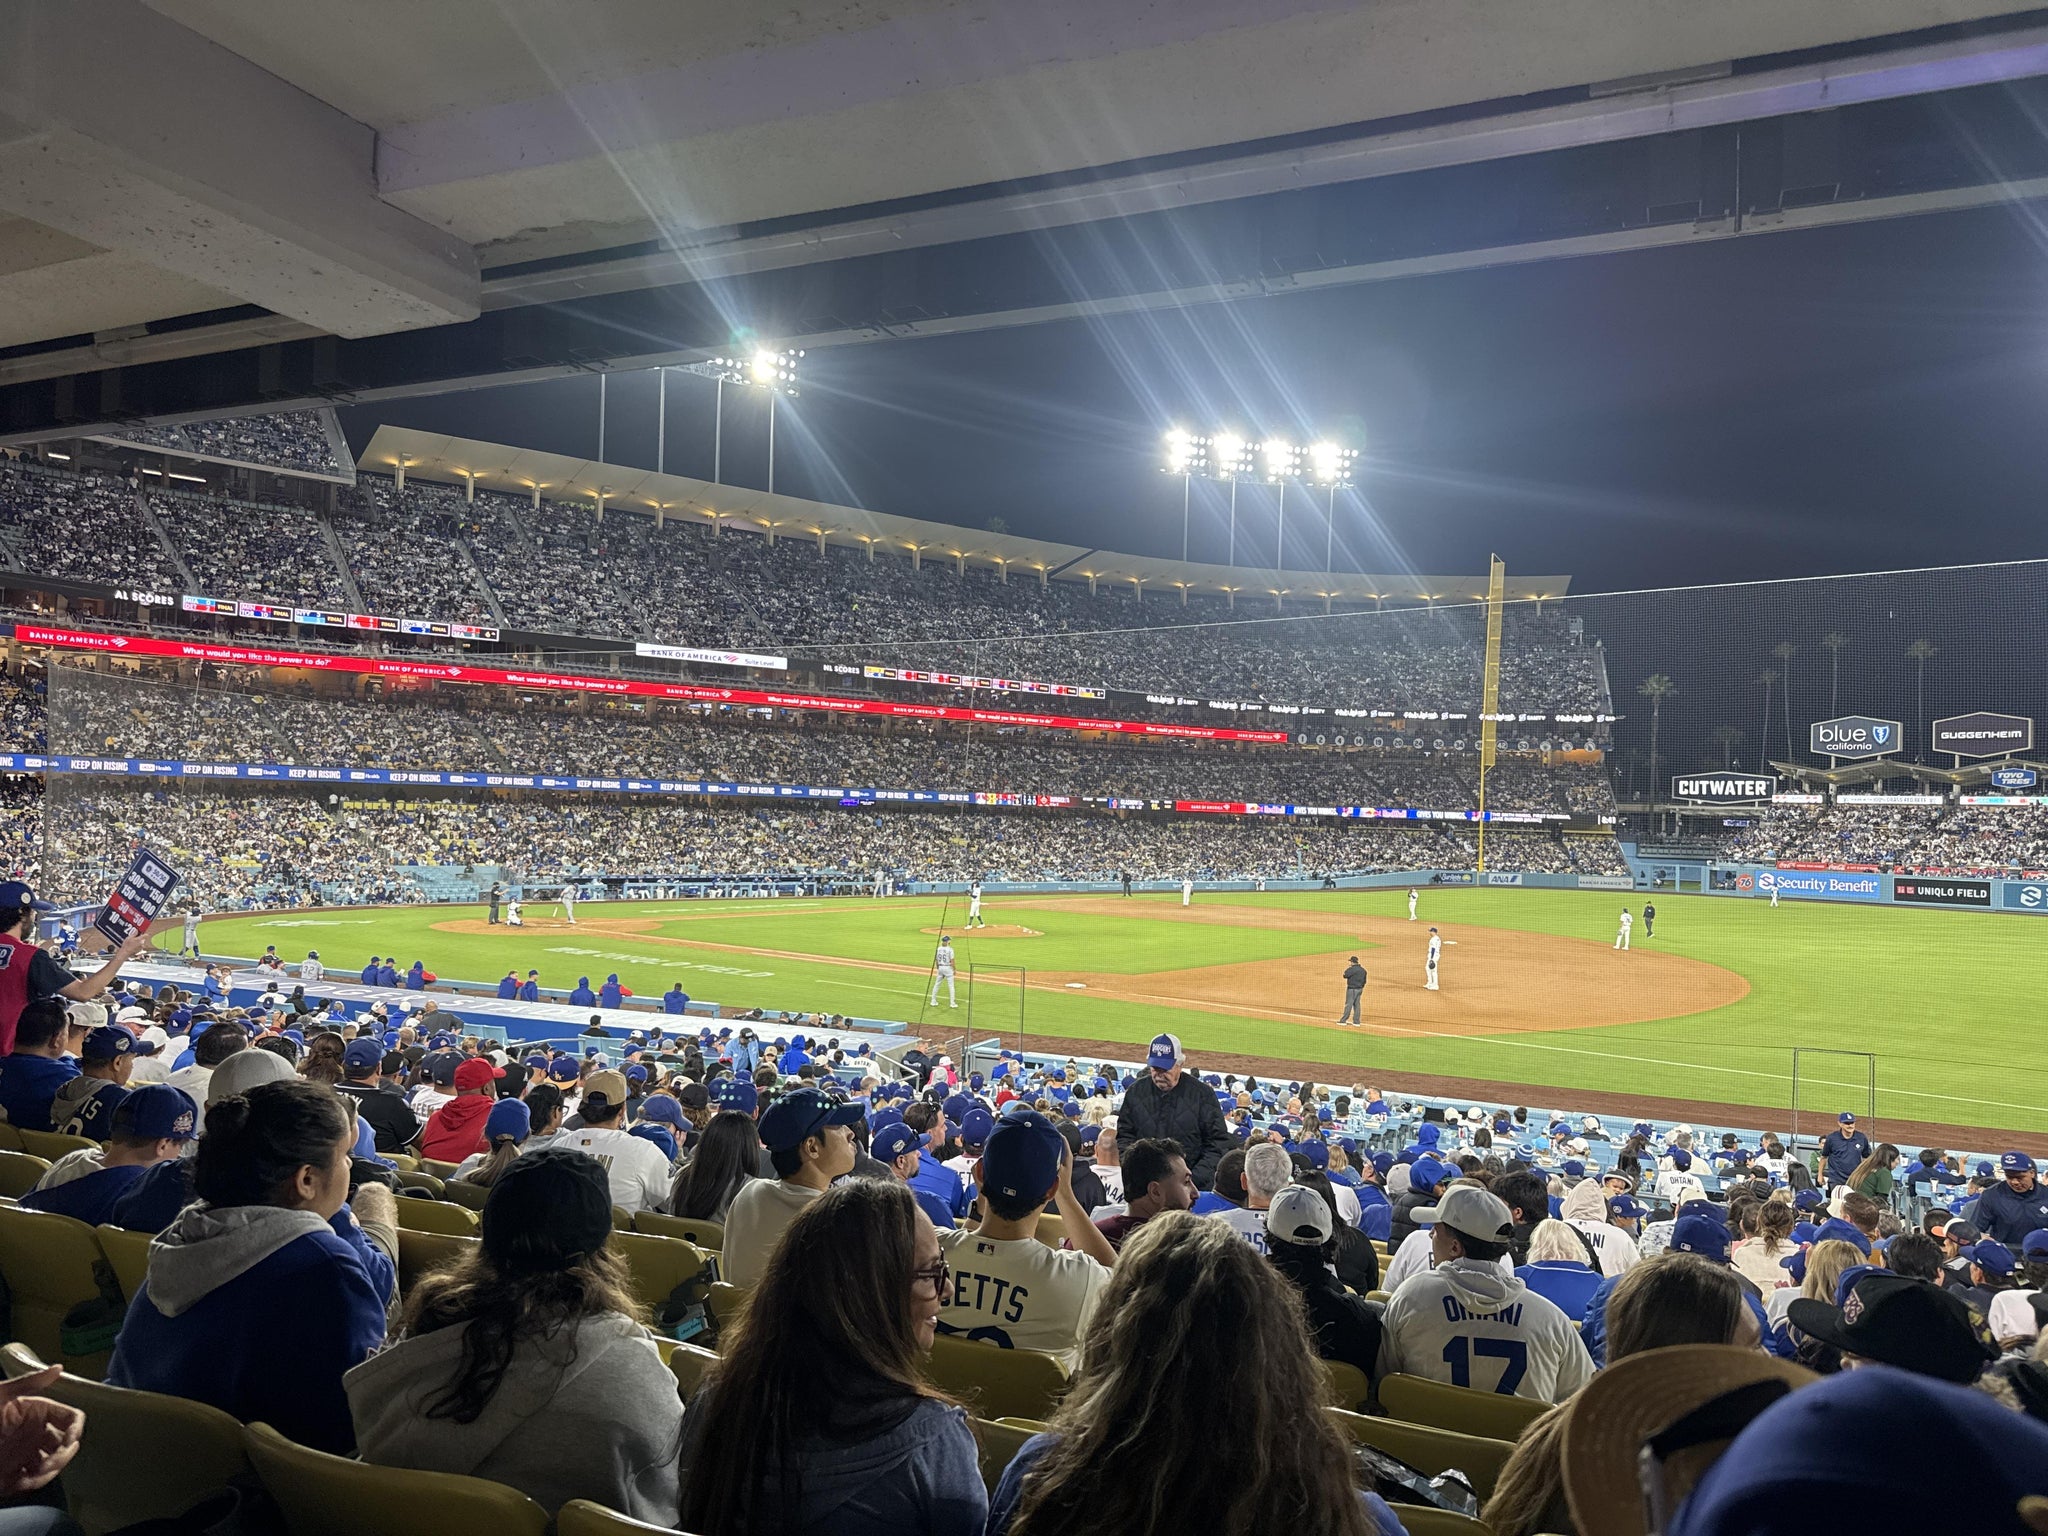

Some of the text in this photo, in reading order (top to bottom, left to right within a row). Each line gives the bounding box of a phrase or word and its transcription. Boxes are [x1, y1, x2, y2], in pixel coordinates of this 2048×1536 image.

[114, 589, 174, 606] AL SCORES
[217, 604, 234, 612] FINAL
[272, 610, 289, 618] FINAL
[29, 632, 108, 646] BANK OF AMERICA
[183, 646, 204, 656] What
[206, 649, 230, 658] would
[232, 652, 246, 660] you
[264, 654, 277, 662] the
[278, 656, 303, 666] power
[304, 657, 314, 665] to
[687, 653, 722, 662] AMERICA
[380, 664, 400, 672] BANK
[824, 664, 833, 672] NL
[834, 665, 860, 674] SCORES
[506, 674, 525, 682] What
[526, 676, 546, 684] would
[586, 682, 606, 690] power
[1820, 726, 1867, 742] blue
[1940, 730, 2022, 740] GUGGENHEIM
[1826, 742, 1872, 750] california
[0, 757, 14, 767] ING
[70, 760, 128, 772] KEEP ON RISING
[182, 764, 238, 776] KEEP ON RISING
[289, 769, 341, 779] KEEP ON RISING
[390, 773, 441, 782] KEEP ON RISING
[486, 776, 503, 784] KEEP
[513, 778, 534, 786] RISING
[576, 780, 620, 788] KEEP ON RISING
[1678, 780, 1767, 796] CUTWATER
[128, 871, 144, 889] 300
[1491, 875, 1508, 883] ANA
[1740, 878, 1752, 886] 76
[1777, 876, 1874, 893] Security Benefit
[121, 884, 136, 900] 150
[1918, 886, 1988, 898] UNIQLO FIELD
[118, 902, 130, 914] 50
[108, 912, 120, 924] 10
[304, 966, 314, 977] 32
[243, 977, 427, 1003] DODGER
[1670, 1176, 1694, 1186] OHTANI
[1584, 1232, 1605, 1249] ANI
[941, 1270, 1029, 1323] ETTS
[1442, 1336, 1528, 1396] 17
